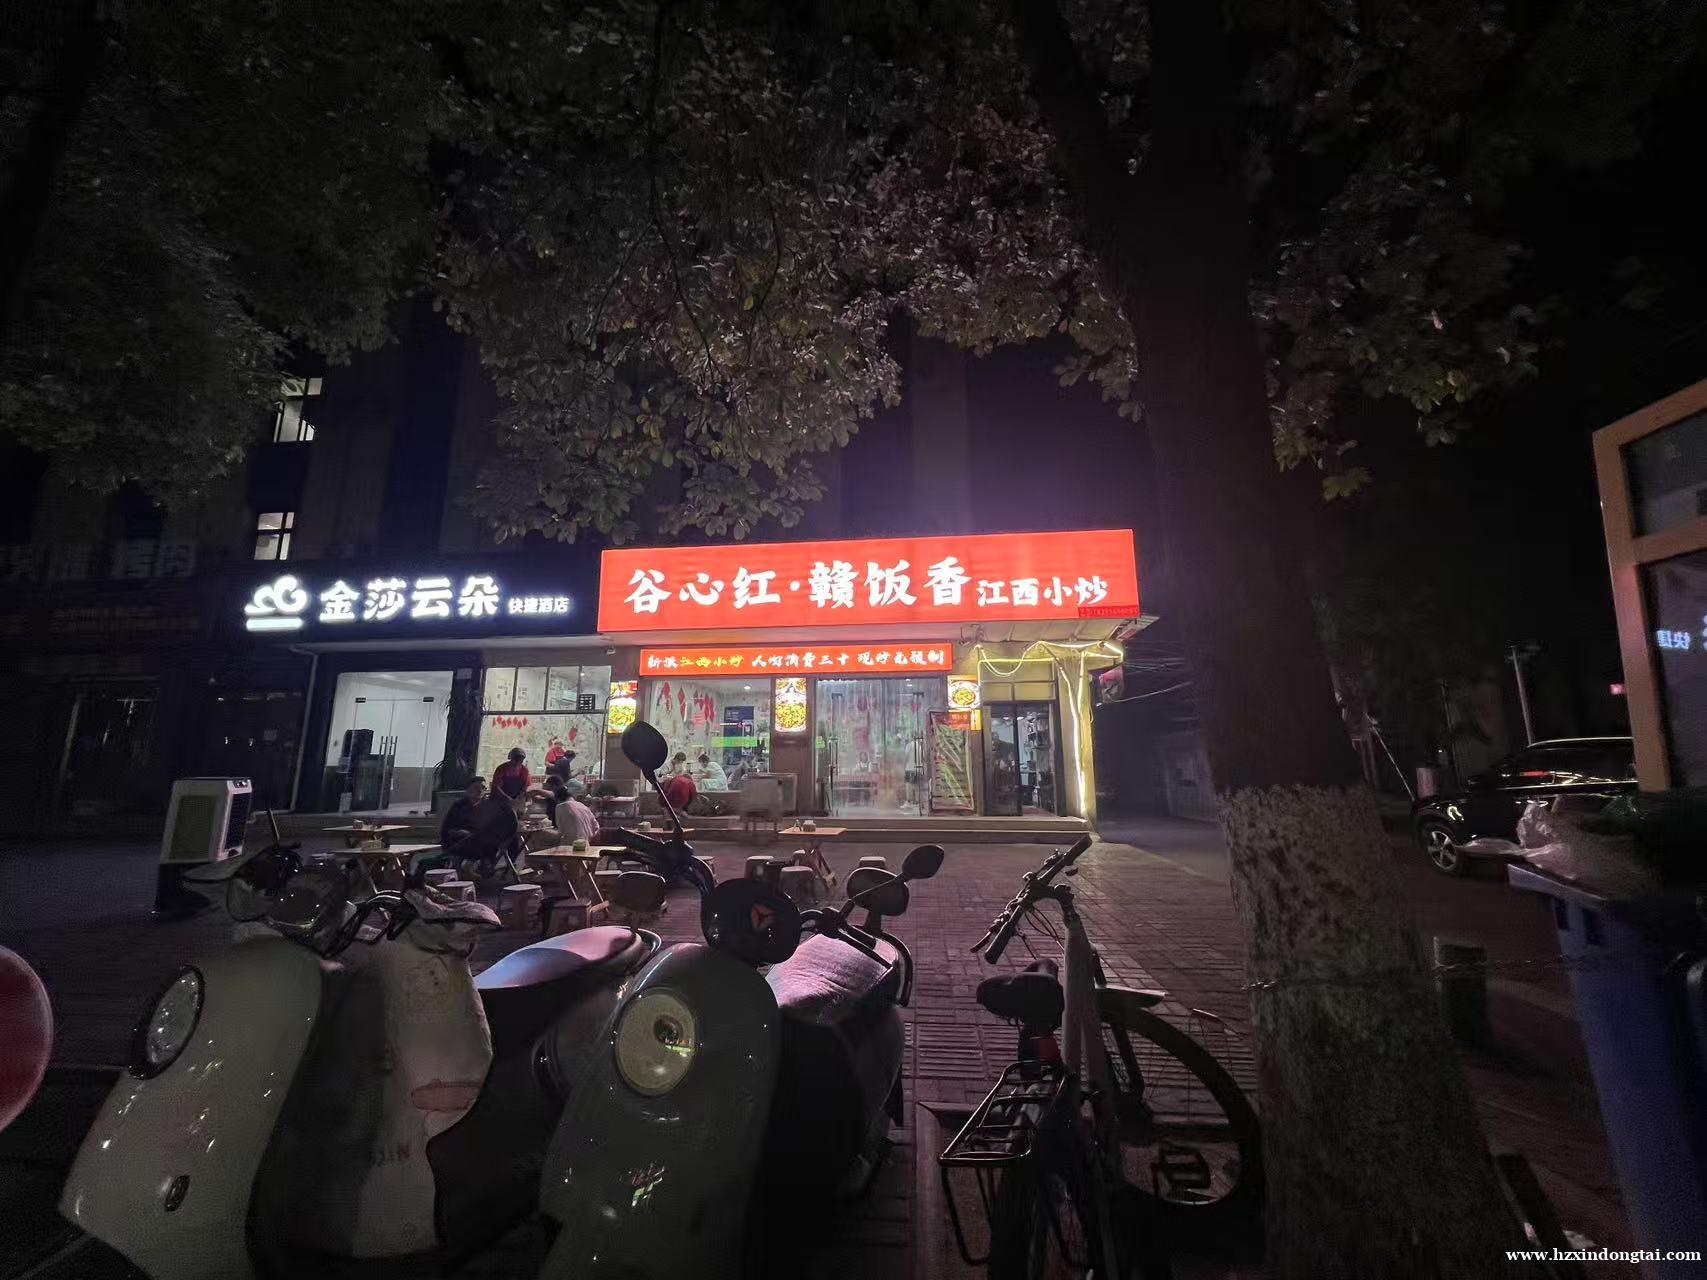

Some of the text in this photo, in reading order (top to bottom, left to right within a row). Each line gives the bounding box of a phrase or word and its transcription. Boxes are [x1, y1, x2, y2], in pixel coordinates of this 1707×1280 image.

[319, 575, 568, 624] 金莎云朵 快捷酒店
[624, 557, 1108, 614] 谷心红·赣饭香 江西小炒
